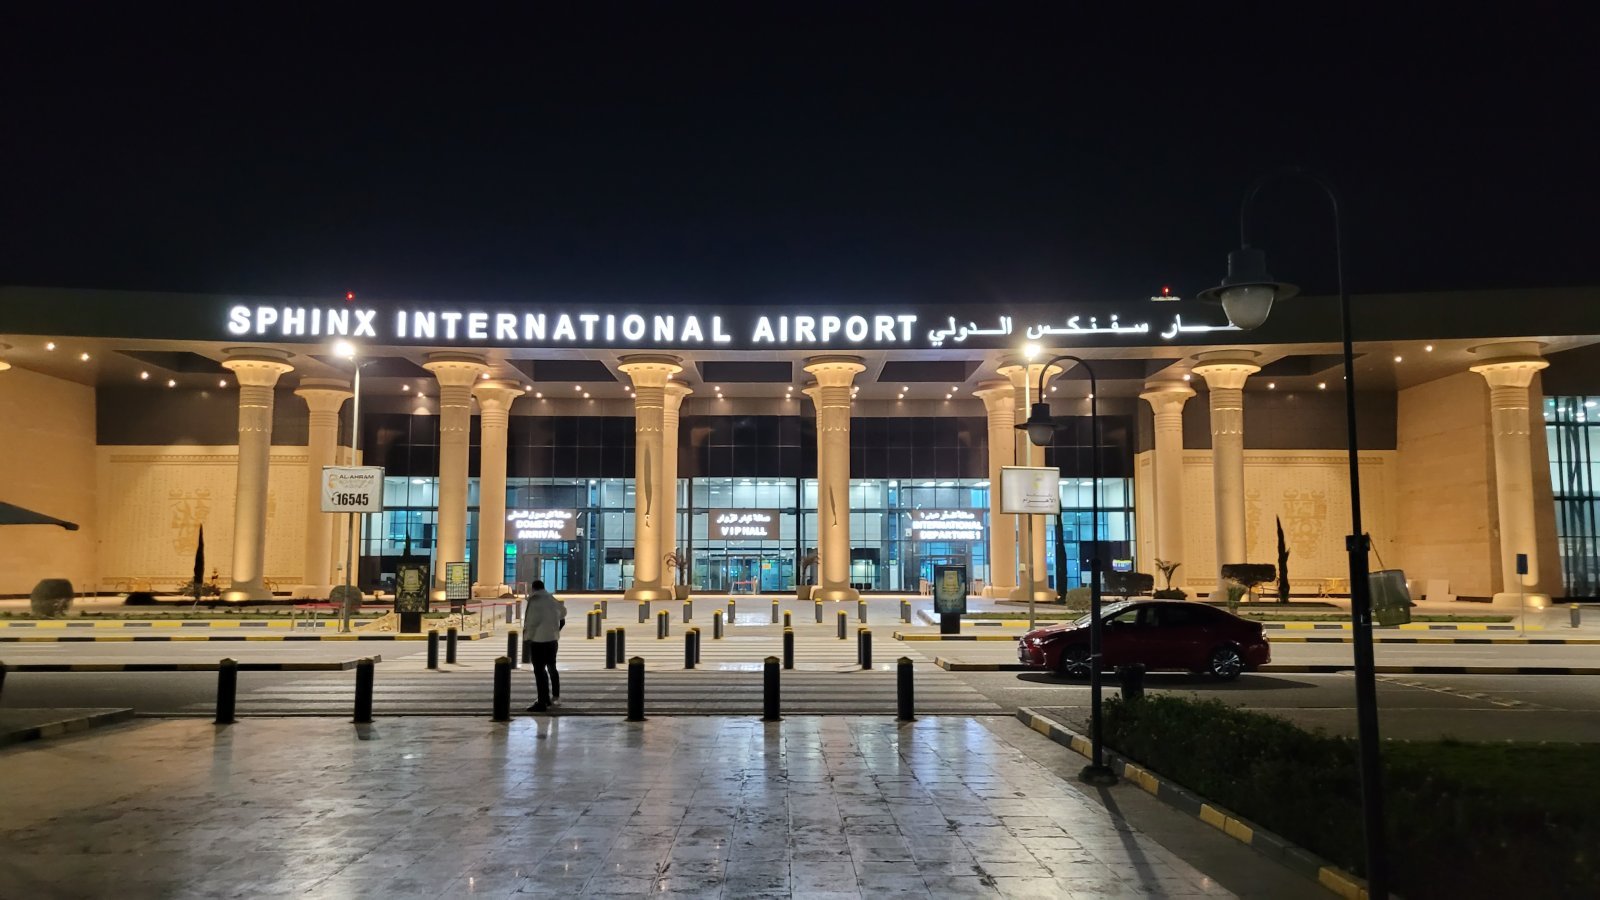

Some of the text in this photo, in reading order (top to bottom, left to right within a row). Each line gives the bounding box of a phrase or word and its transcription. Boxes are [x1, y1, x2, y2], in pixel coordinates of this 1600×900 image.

[229, 306, 918, 343] SPHINX INTERNATIONAL AIRPORT
[928, 314, 1242, 347] ار سفنكس الدولي
[337, 493, 369, 506] 16545
[515, 520, 565, 529] DOMESTIC
[912, 521, 983, 530] INTERNATIONAL
[518, 530, 561, 539] ARRIVAL
[721, 526, 767, 536] VIP HALL
[920, 530, 975, 539] DEPARTURE
